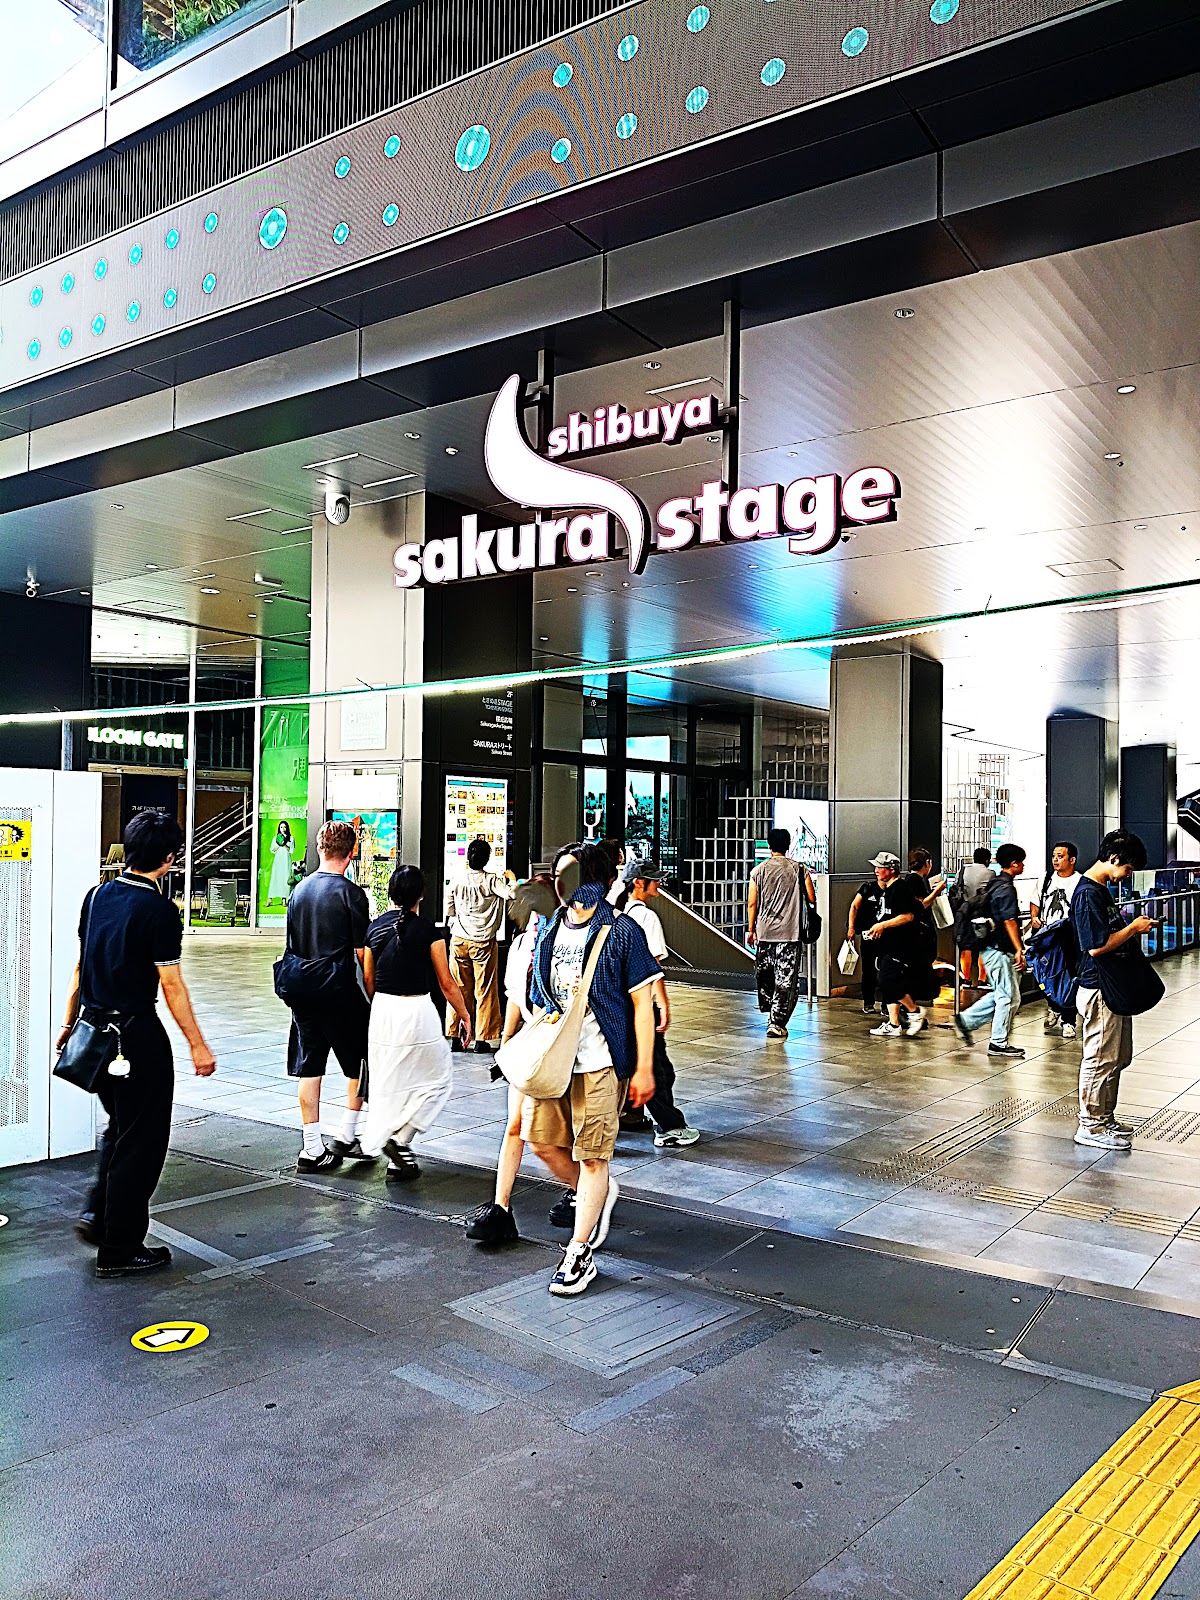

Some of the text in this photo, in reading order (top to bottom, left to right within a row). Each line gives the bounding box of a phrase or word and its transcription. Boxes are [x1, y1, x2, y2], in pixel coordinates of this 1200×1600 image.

[547, 394, 713, 458] shibuya
[656, 465, 898, 555] stage
[392, 512, 611, 588] sakura
[143, 730, 184, 749] GATE
